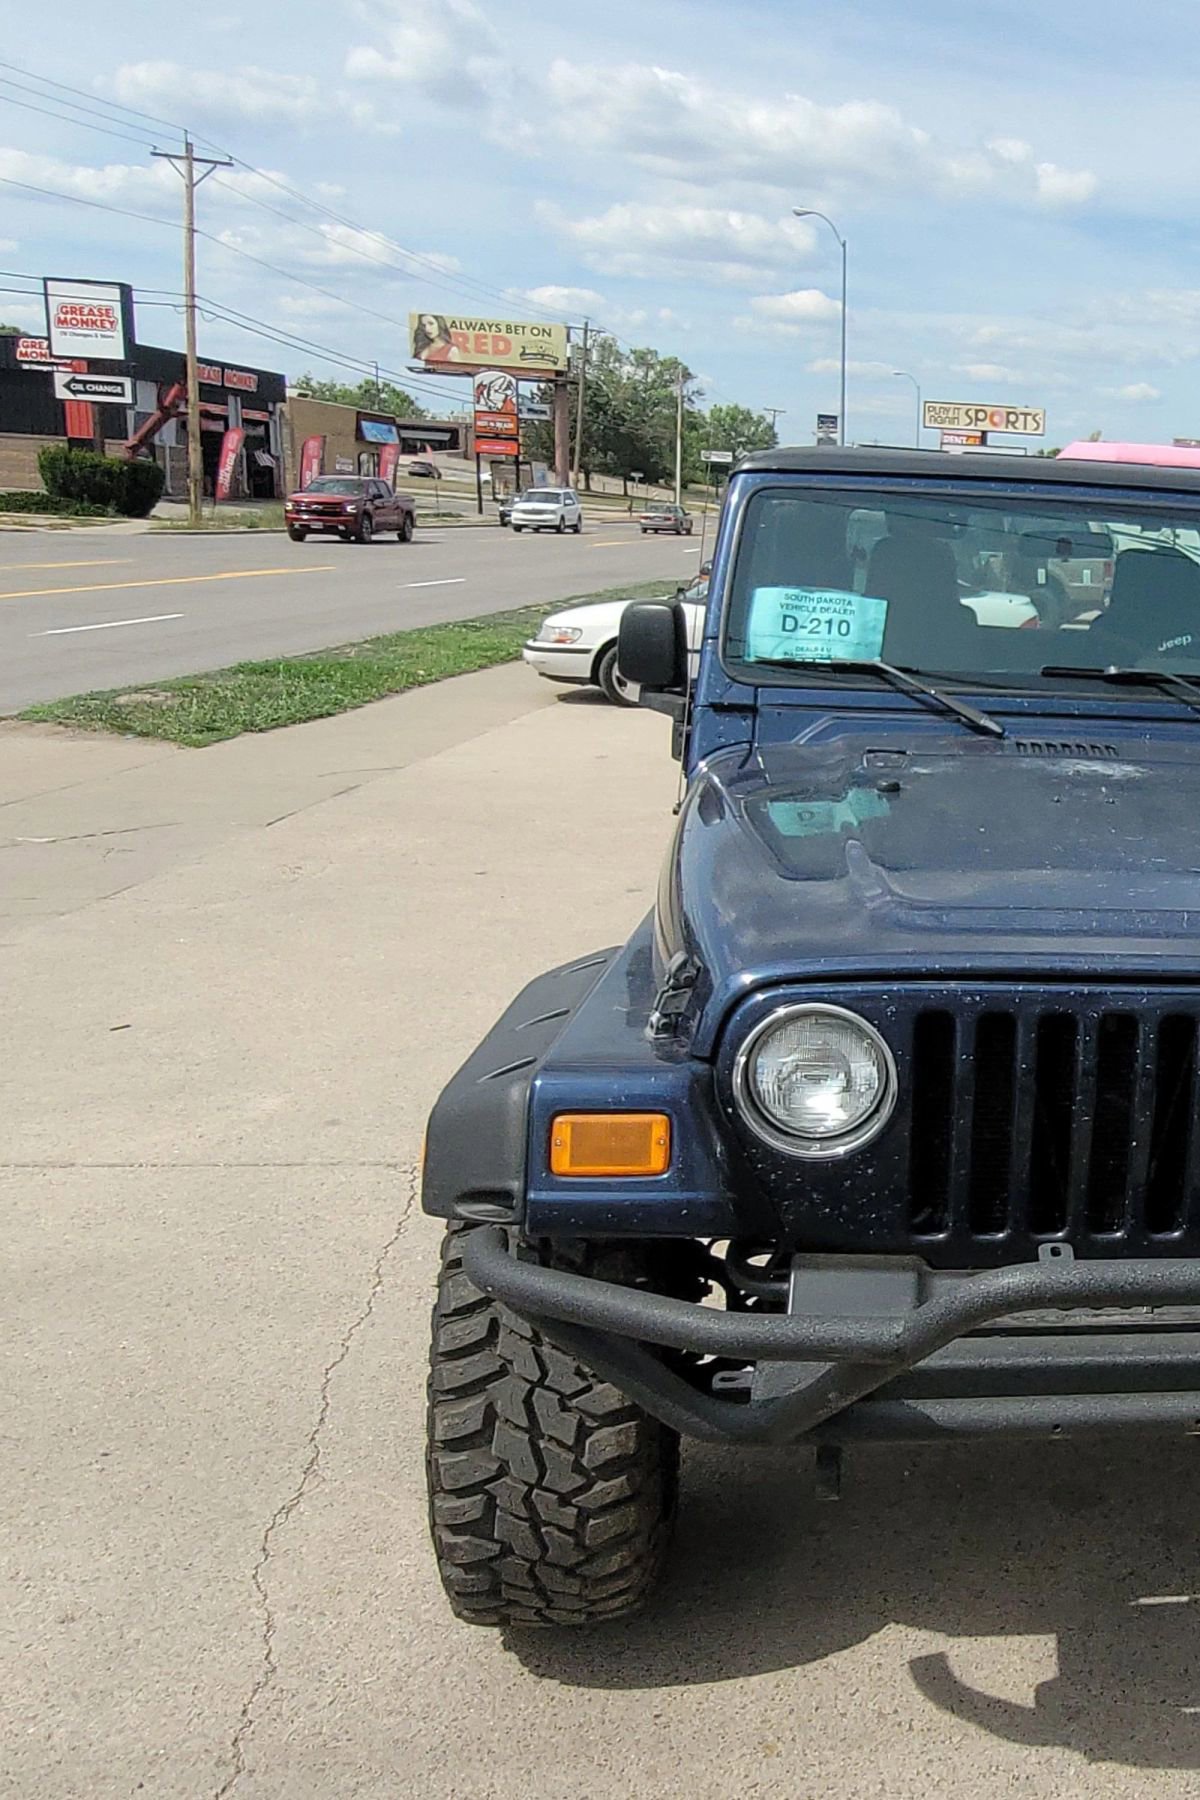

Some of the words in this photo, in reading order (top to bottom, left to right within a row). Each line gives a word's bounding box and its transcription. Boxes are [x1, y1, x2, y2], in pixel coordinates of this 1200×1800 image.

[60, 305, 112, 318] GREASE
[56, 316, 116, 329] MONKEY
[449, 320, 502, 333] ALWAYS
[505, 323, 527, 335] BET
[530, 326, 552, 338] ON
[21, 340, 48, 350] GRE
[451, 332, 512, 357] RED
[19, 351, 48, 359] MON
[70, 383, 85, 391] OIL
[86, 384, 123, 394] CHANGE
[927, 405, 950, 415] PLAY
[952, 407, 962, 416] IT
[964, 408, 1041, 431] SPORTS
[784, 593, 815, 603] SOUTH
[816, 596, 853, 607] DAKOTA
[779, 603, 817, 613] VEHICLE
[820, 606, 855, 616] DEALER
[781, 614, 851, 637] D-210
[1158, 633, 1192, 652] Jeep
